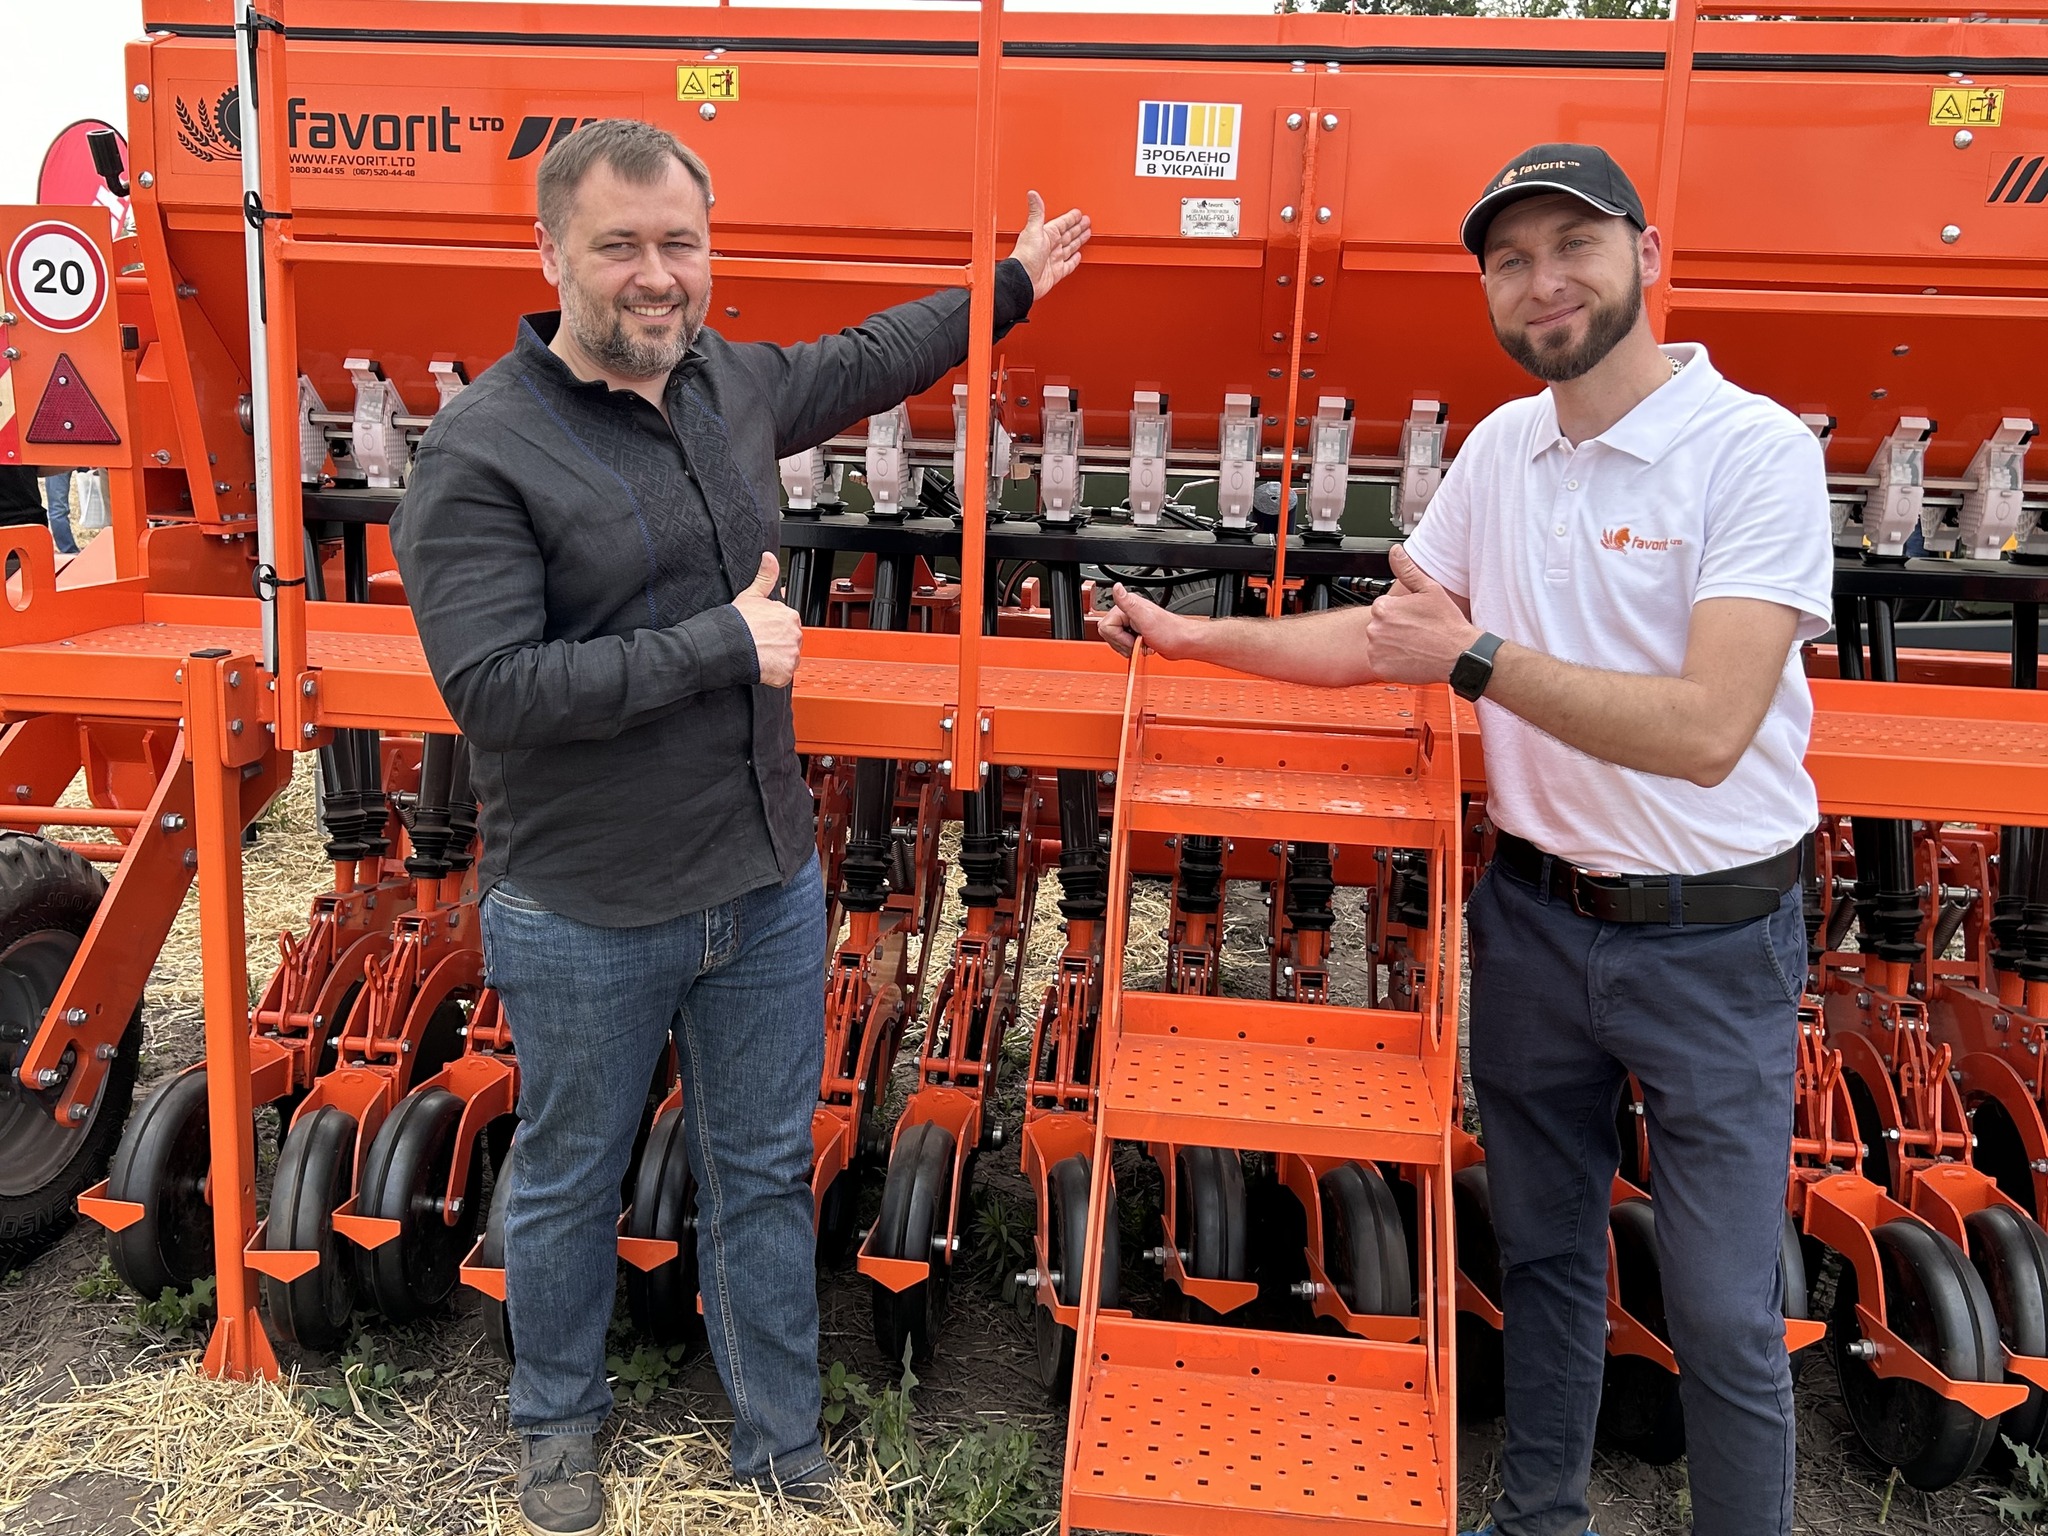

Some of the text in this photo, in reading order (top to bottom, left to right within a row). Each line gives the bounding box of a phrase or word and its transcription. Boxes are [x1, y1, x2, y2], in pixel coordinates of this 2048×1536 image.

[287, 97, 505, 153] favorit LTD
[289, 153, 416, 167] WWW.FAVORIT.LTD
[1142, 148, 1231, 164] ЗРОБЛЕНО
[295, 166, 311, 174] 800
[322, 167, 334, 175] 44
[335, 167, 345, 175] 55
[352, 168, 373, 176] (067)
[373, 168, 416, 177] 520-44-48
[1146, 163, 1225, 178] В УКРАЇНІ
[1518, 160, 1566, 176] favorit
[32, 258, 85, 296] 20
[1631, 536, 1668, 551] favorit
